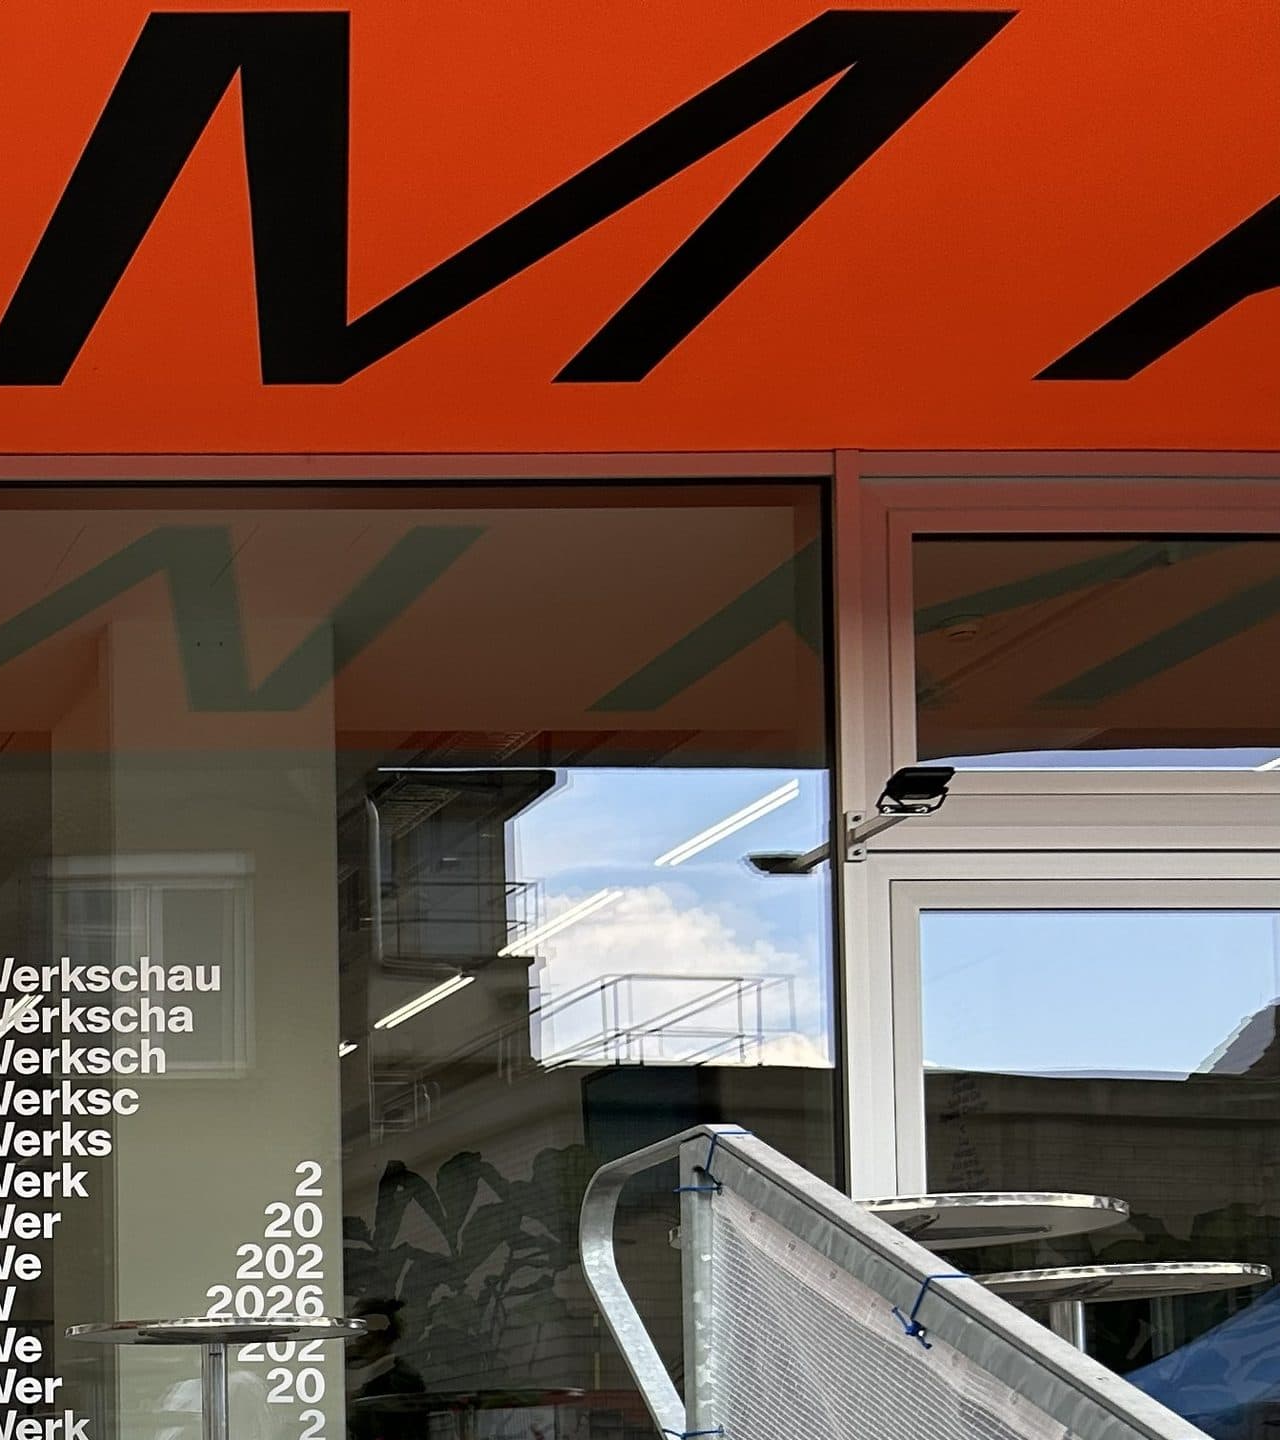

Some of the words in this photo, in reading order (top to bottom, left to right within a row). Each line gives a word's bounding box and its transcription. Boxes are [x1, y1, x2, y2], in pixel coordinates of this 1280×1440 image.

[295, 1162, 323, 1197] 2
[265, 1203, 323, 1238] 20
[236, 1244, 324, 1279] 202
[206, 1285, 325, 1317] 2026
[267, 1368, 325, 1403] 20
